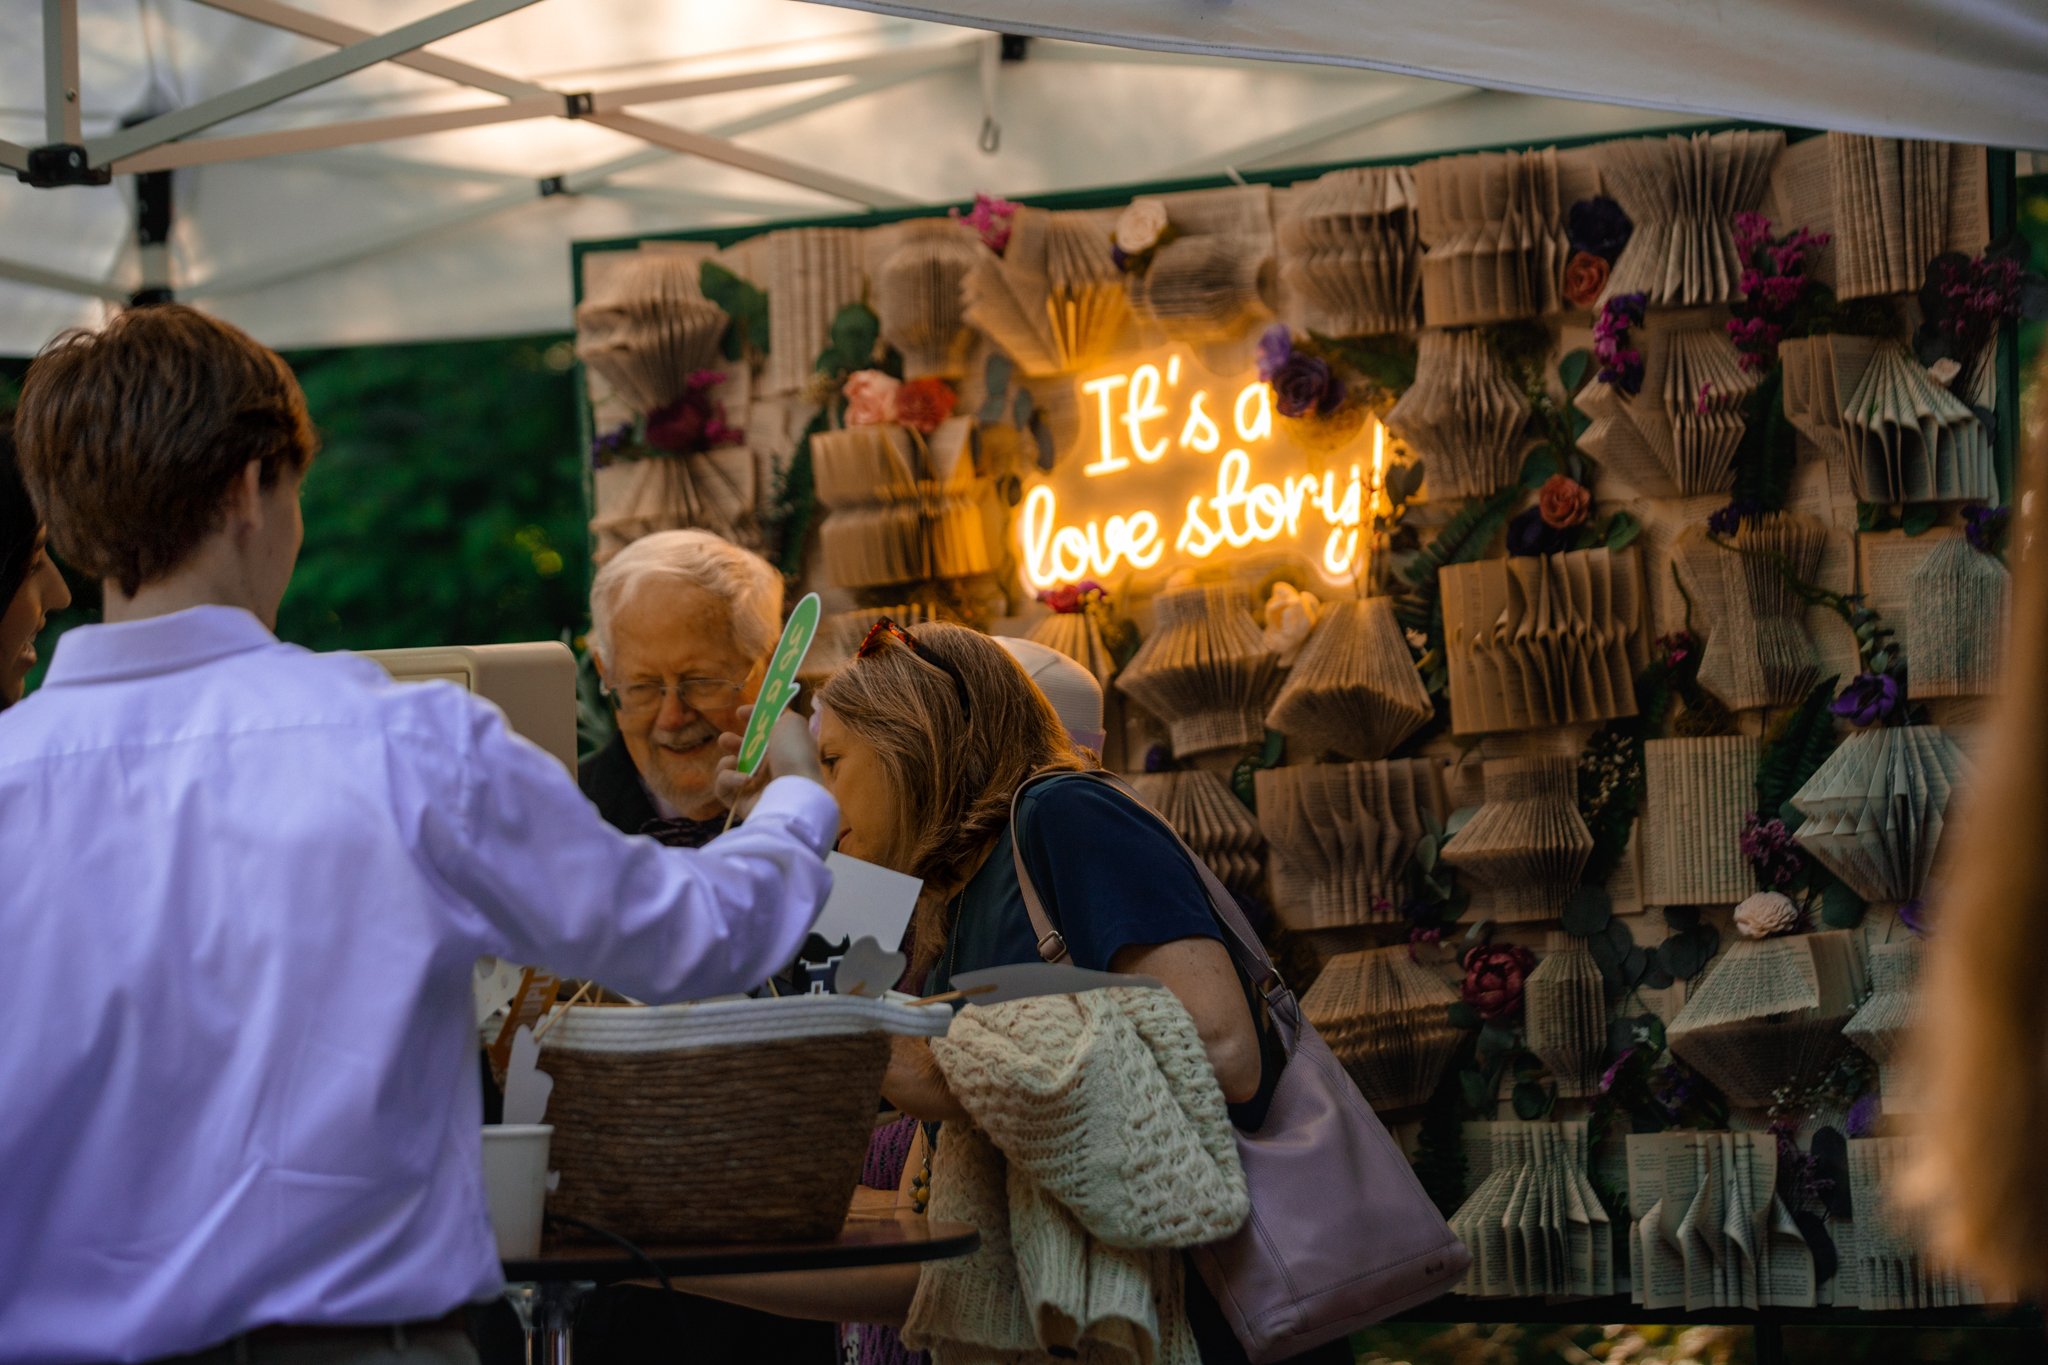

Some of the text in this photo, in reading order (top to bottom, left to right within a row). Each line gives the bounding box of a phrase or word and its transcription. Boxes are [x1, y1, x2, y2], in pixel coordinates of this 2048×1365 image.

[1082, 354, 1273, 477] It's a
[1022, 484, 1165, 588] love
[1175, 418, 1386, 576] story!
[746, 622, 805, 760] yay
